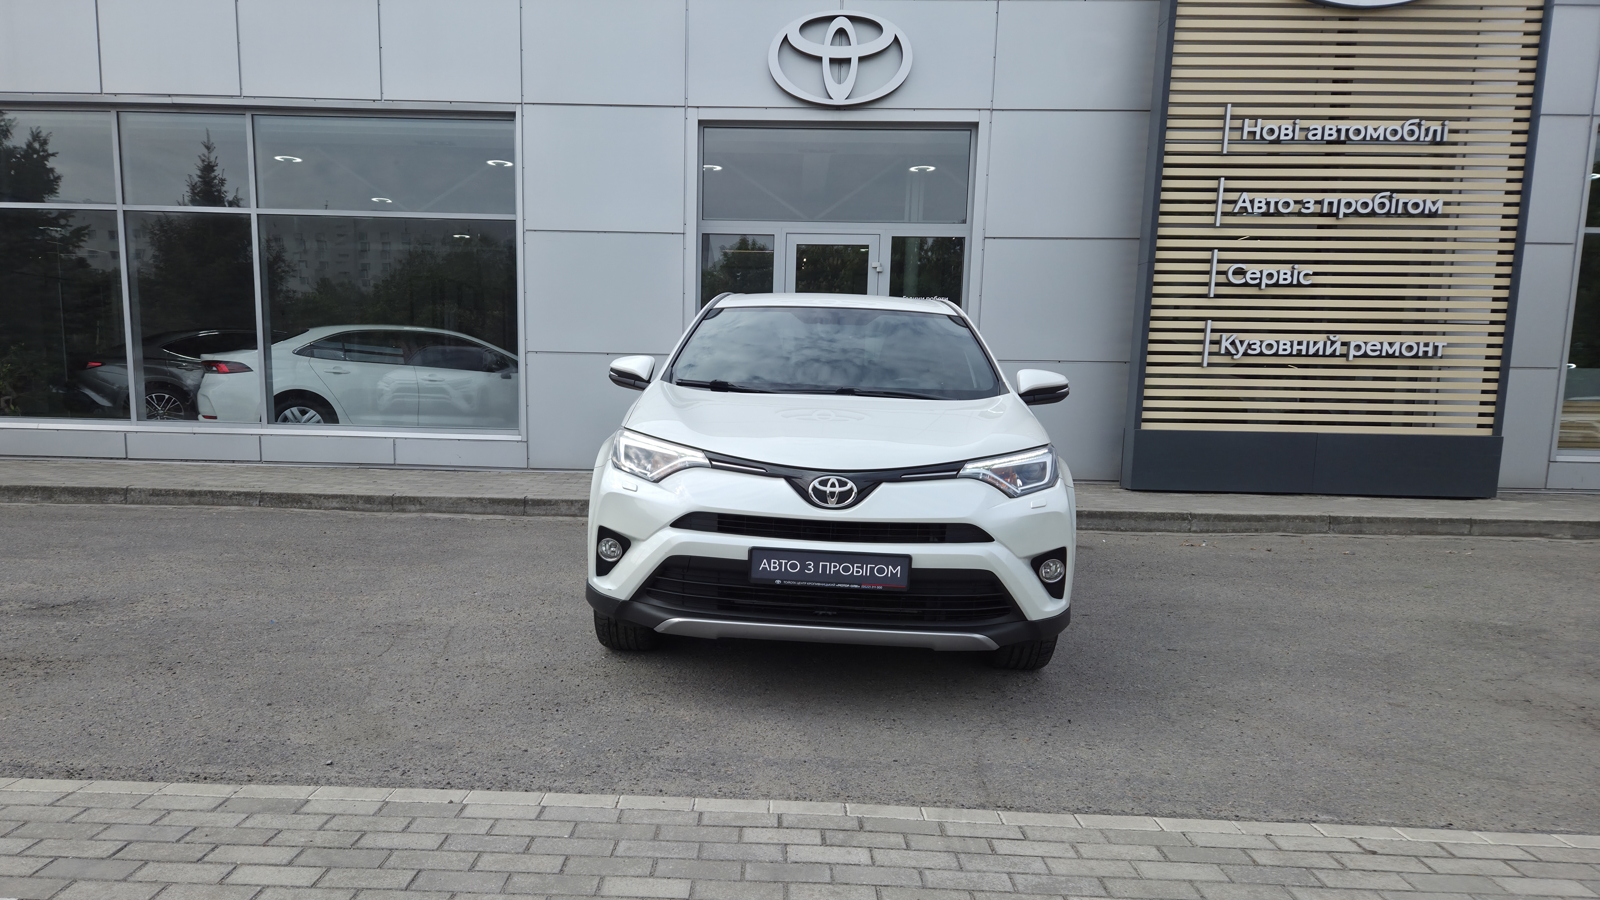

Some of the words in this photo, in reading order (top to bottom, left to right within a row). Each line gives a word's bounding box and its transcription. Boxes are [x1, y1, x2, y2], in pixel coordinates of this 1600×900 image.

[1241, 118, 1301, 141] Нові
[1305, 118, 1450, 142] автомобілі
[1232, 191, 1295, 214] Авто
[1299, 197, 1315, 214] з
[1320, 191, 1444, 220] пробігом
[1226, 263, 1314, 290] Сервіс
[1219, 334, 1342, 360] Кузовний
[1346, 341, 1447, 361] ремонт
[759, 558, 801, 573] АВТО
[804, 561, 815, 574] З
[818, 561, 902, 578] ПРОБІГОМ
